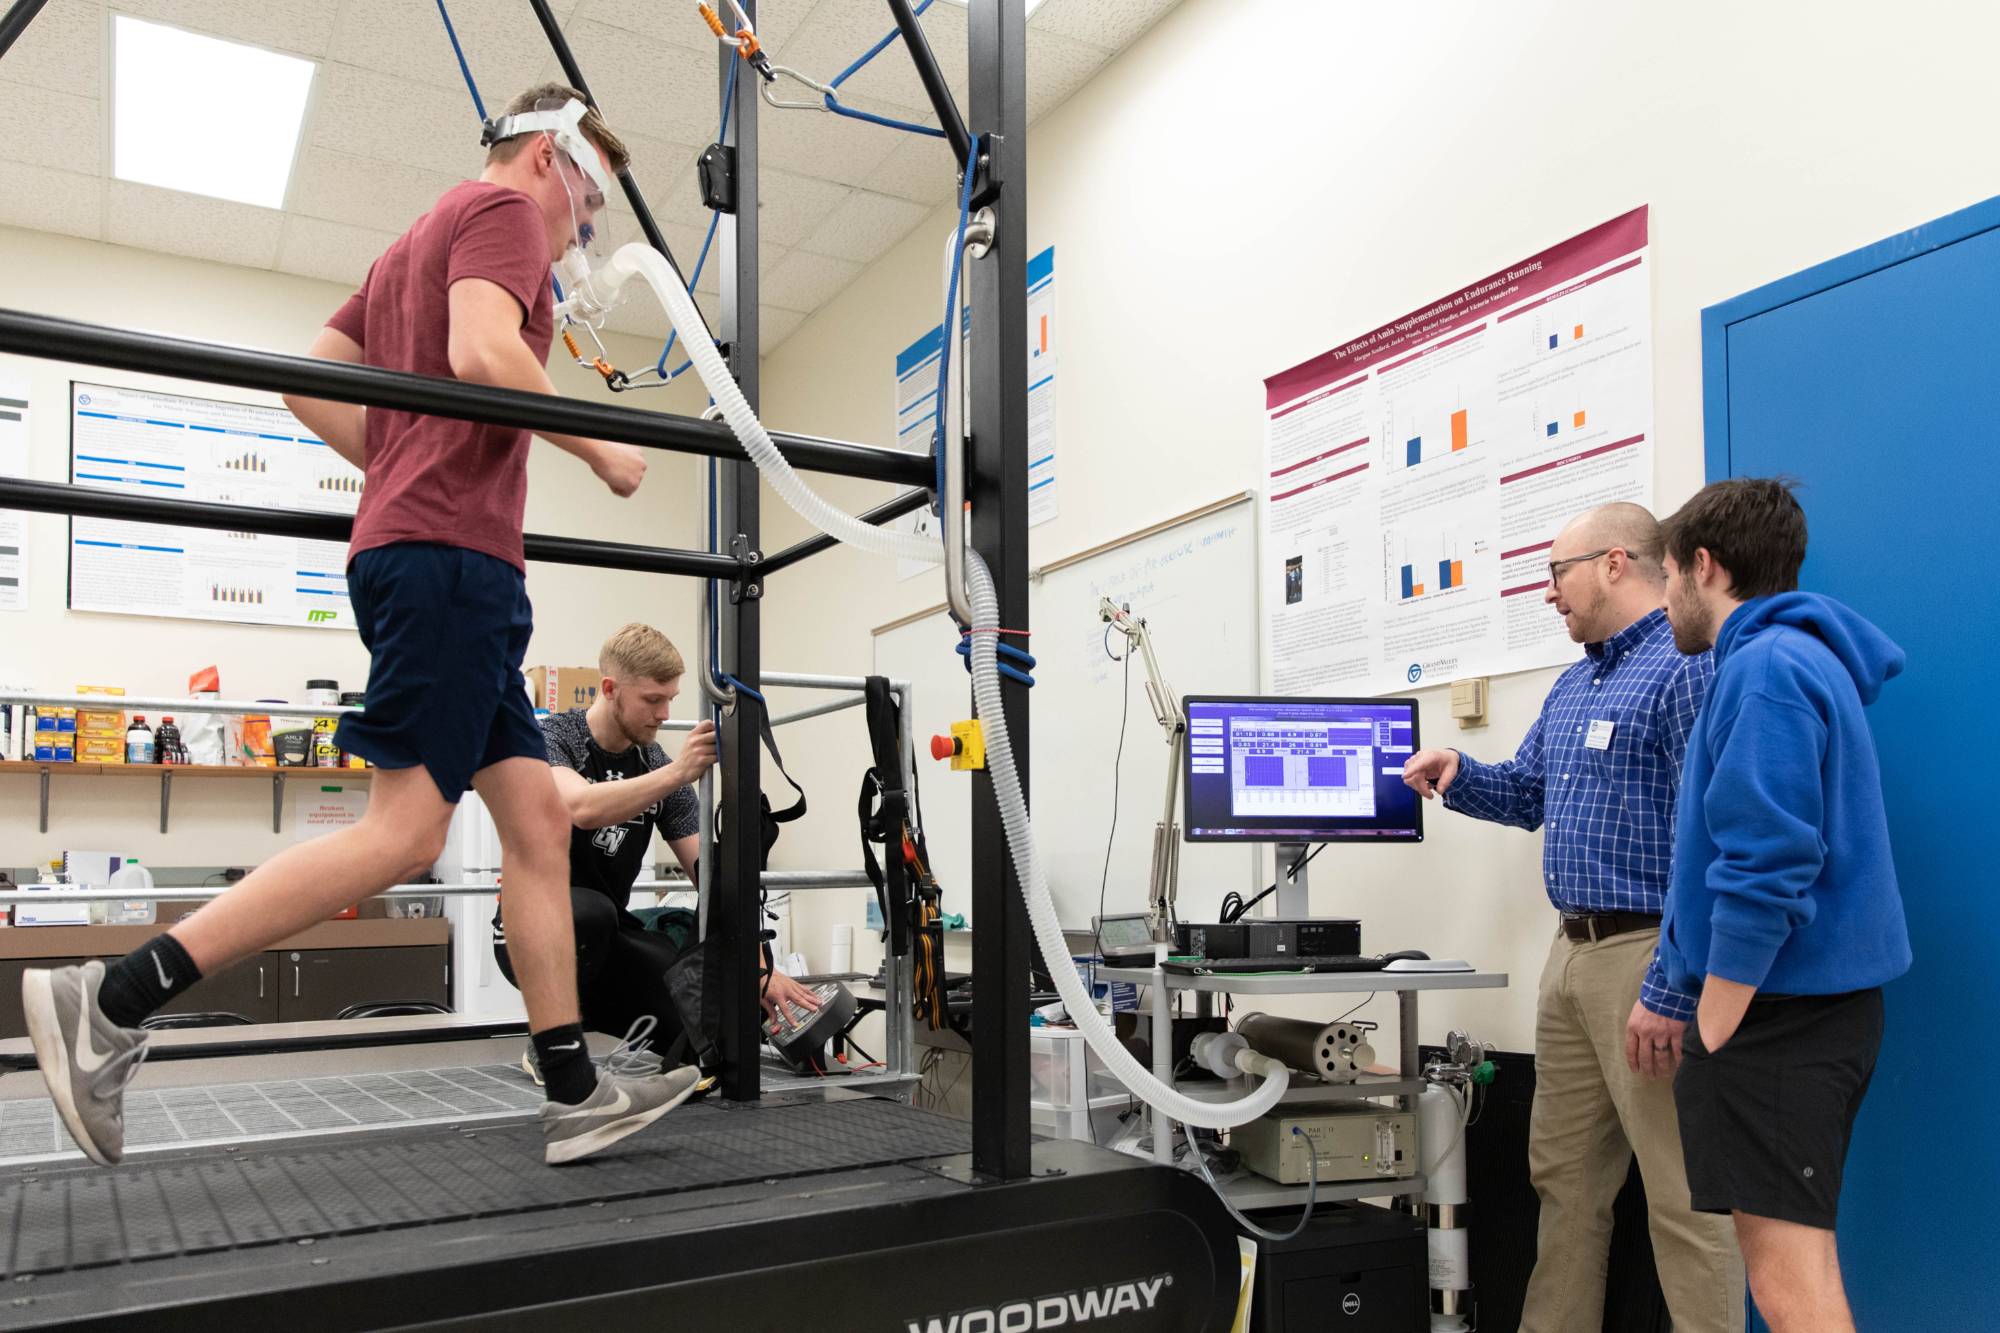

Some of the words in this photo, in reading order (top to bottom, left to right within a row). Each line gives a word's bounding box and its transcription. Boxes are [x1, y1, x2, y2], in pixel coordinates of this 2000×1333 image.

[1333, 350, 1347, 360] The
[1346, 340, 1369, 355] Effects
[1369, 334, 1377, 344] of
[1376, 328, 1395, 341] Amla
[1394, 301, 1453, 333] Supplementation
[1454, 297, 1464, 306] on
[1464, 277, 1507, 301] Endurance
[1506, 260, 1543, 282] Running
[319, 746, 339, 754] C4
